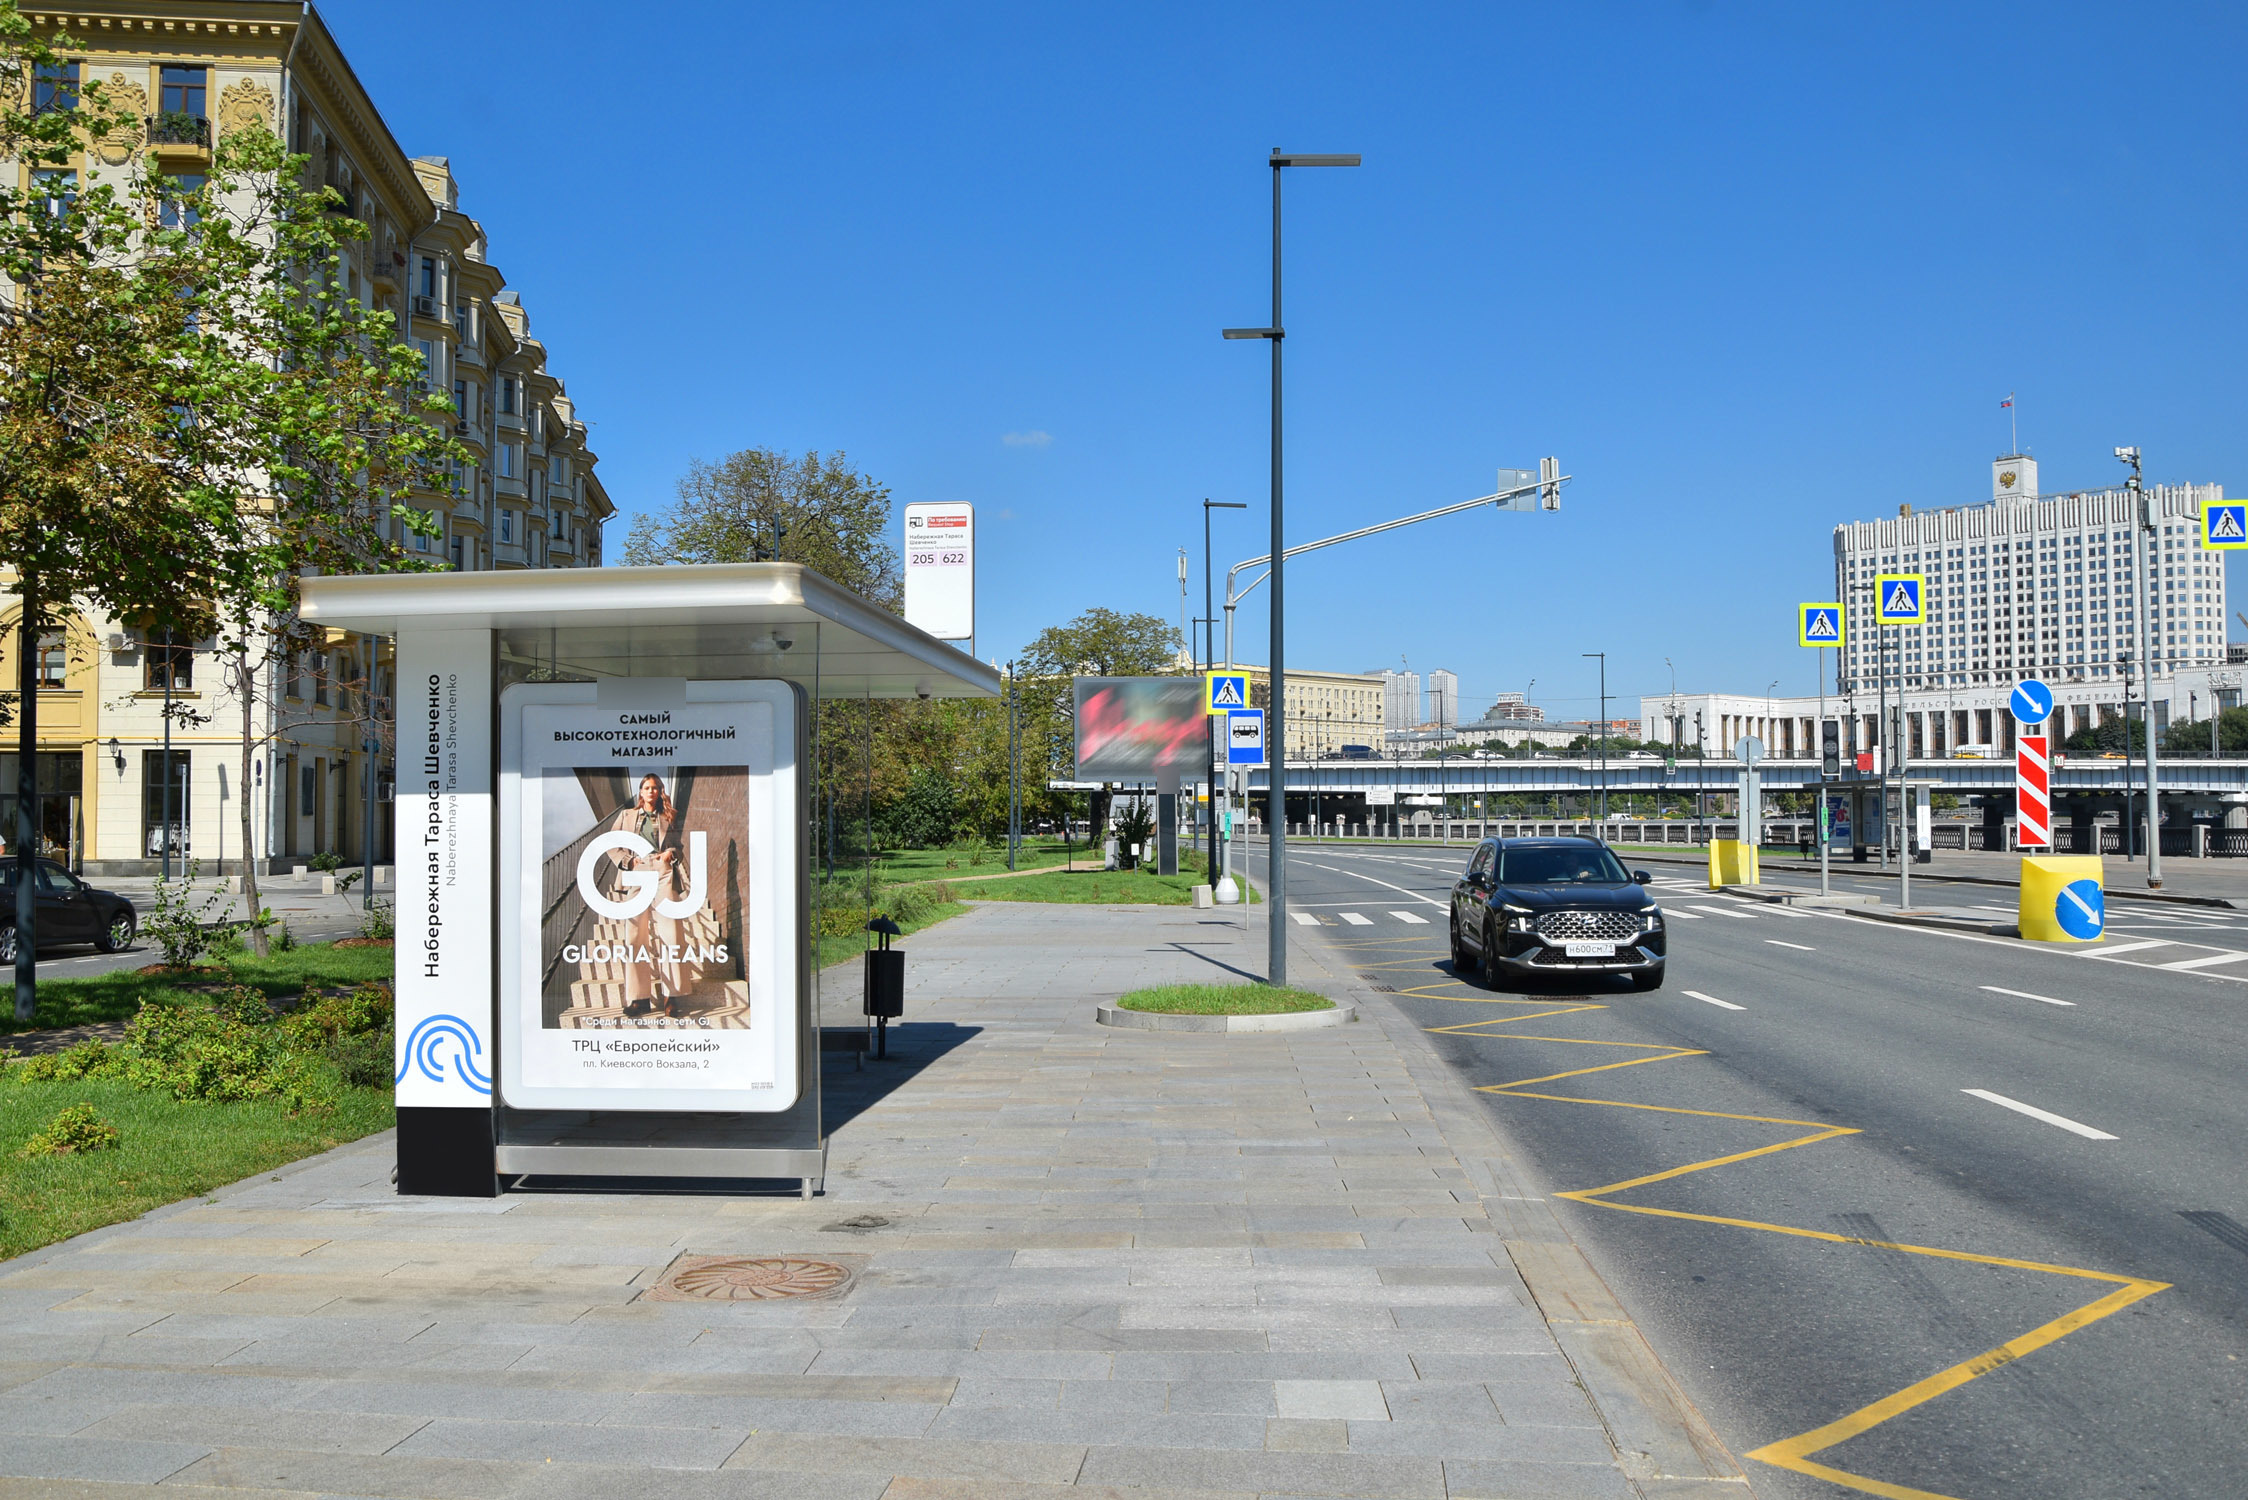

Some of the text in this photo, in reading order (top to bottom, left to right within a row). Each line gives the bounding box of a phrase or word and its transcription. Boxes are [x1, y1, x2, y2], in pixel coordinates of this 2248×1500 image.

[912, 554, 964, 564] 205 622
[1834, 704, 1857, 713] ДО
[619, 711, 671, 724] САМЫЙ
[554, 726, 736, 741] ВЫСОКОТЕХНОЛОГИЧНЫЙ
[446, 674, 459, 886] Naberezhnaya Tarasa Shevchenko
[424, 674, 443, 977] Набережная Тараса Шевченко
[577, 830, 708, 920] GJ
[562, 944, 729, 964] GLORIA JEANS
[620, 1018, 671, 1026] магазинов
[673, 1018, 696, 1026] сети
[698, 1017, 710, 1026] GJ
[572, 1038, 720, 1055] ТРЦ «Европейский»
[583, 1059, 710, 1070] пл. Киевского Вокзала, 2
